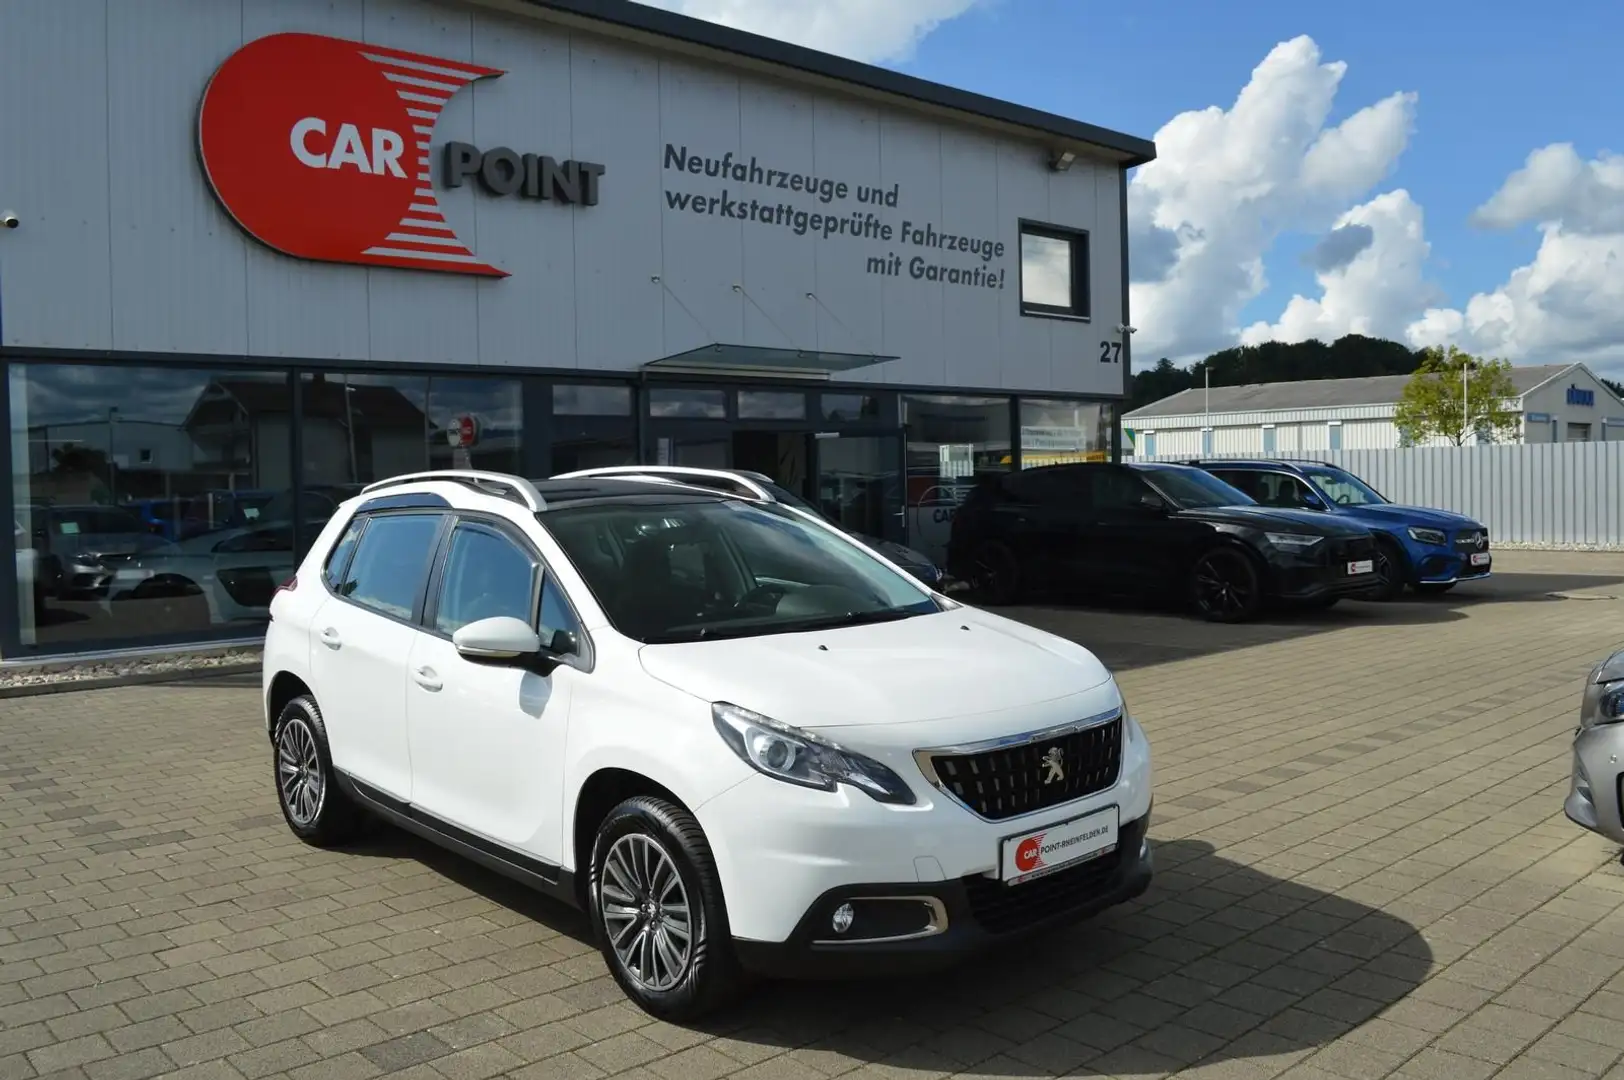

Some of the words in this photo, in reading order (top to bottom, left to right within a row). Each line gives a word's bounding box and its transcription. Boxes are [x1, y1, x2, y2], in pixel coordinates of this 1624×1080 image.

[290, 117, 407, 178] CAR
[444, 141, 604, 206] POINT
[664, 144, 848, 203] Neufahrzeuge
[857, 185, 898, 207] und
[665, 191, 892, 240] werkstattgeprüfte
[902, 221, 1004, 258] Fahrzeuge
[867, 253, 902, 276] mit
[909, 257, 1004, 290] Garantie!
[1100, 341, 1121, 363] 27
[1024, 848, 1037, 860] CAR
